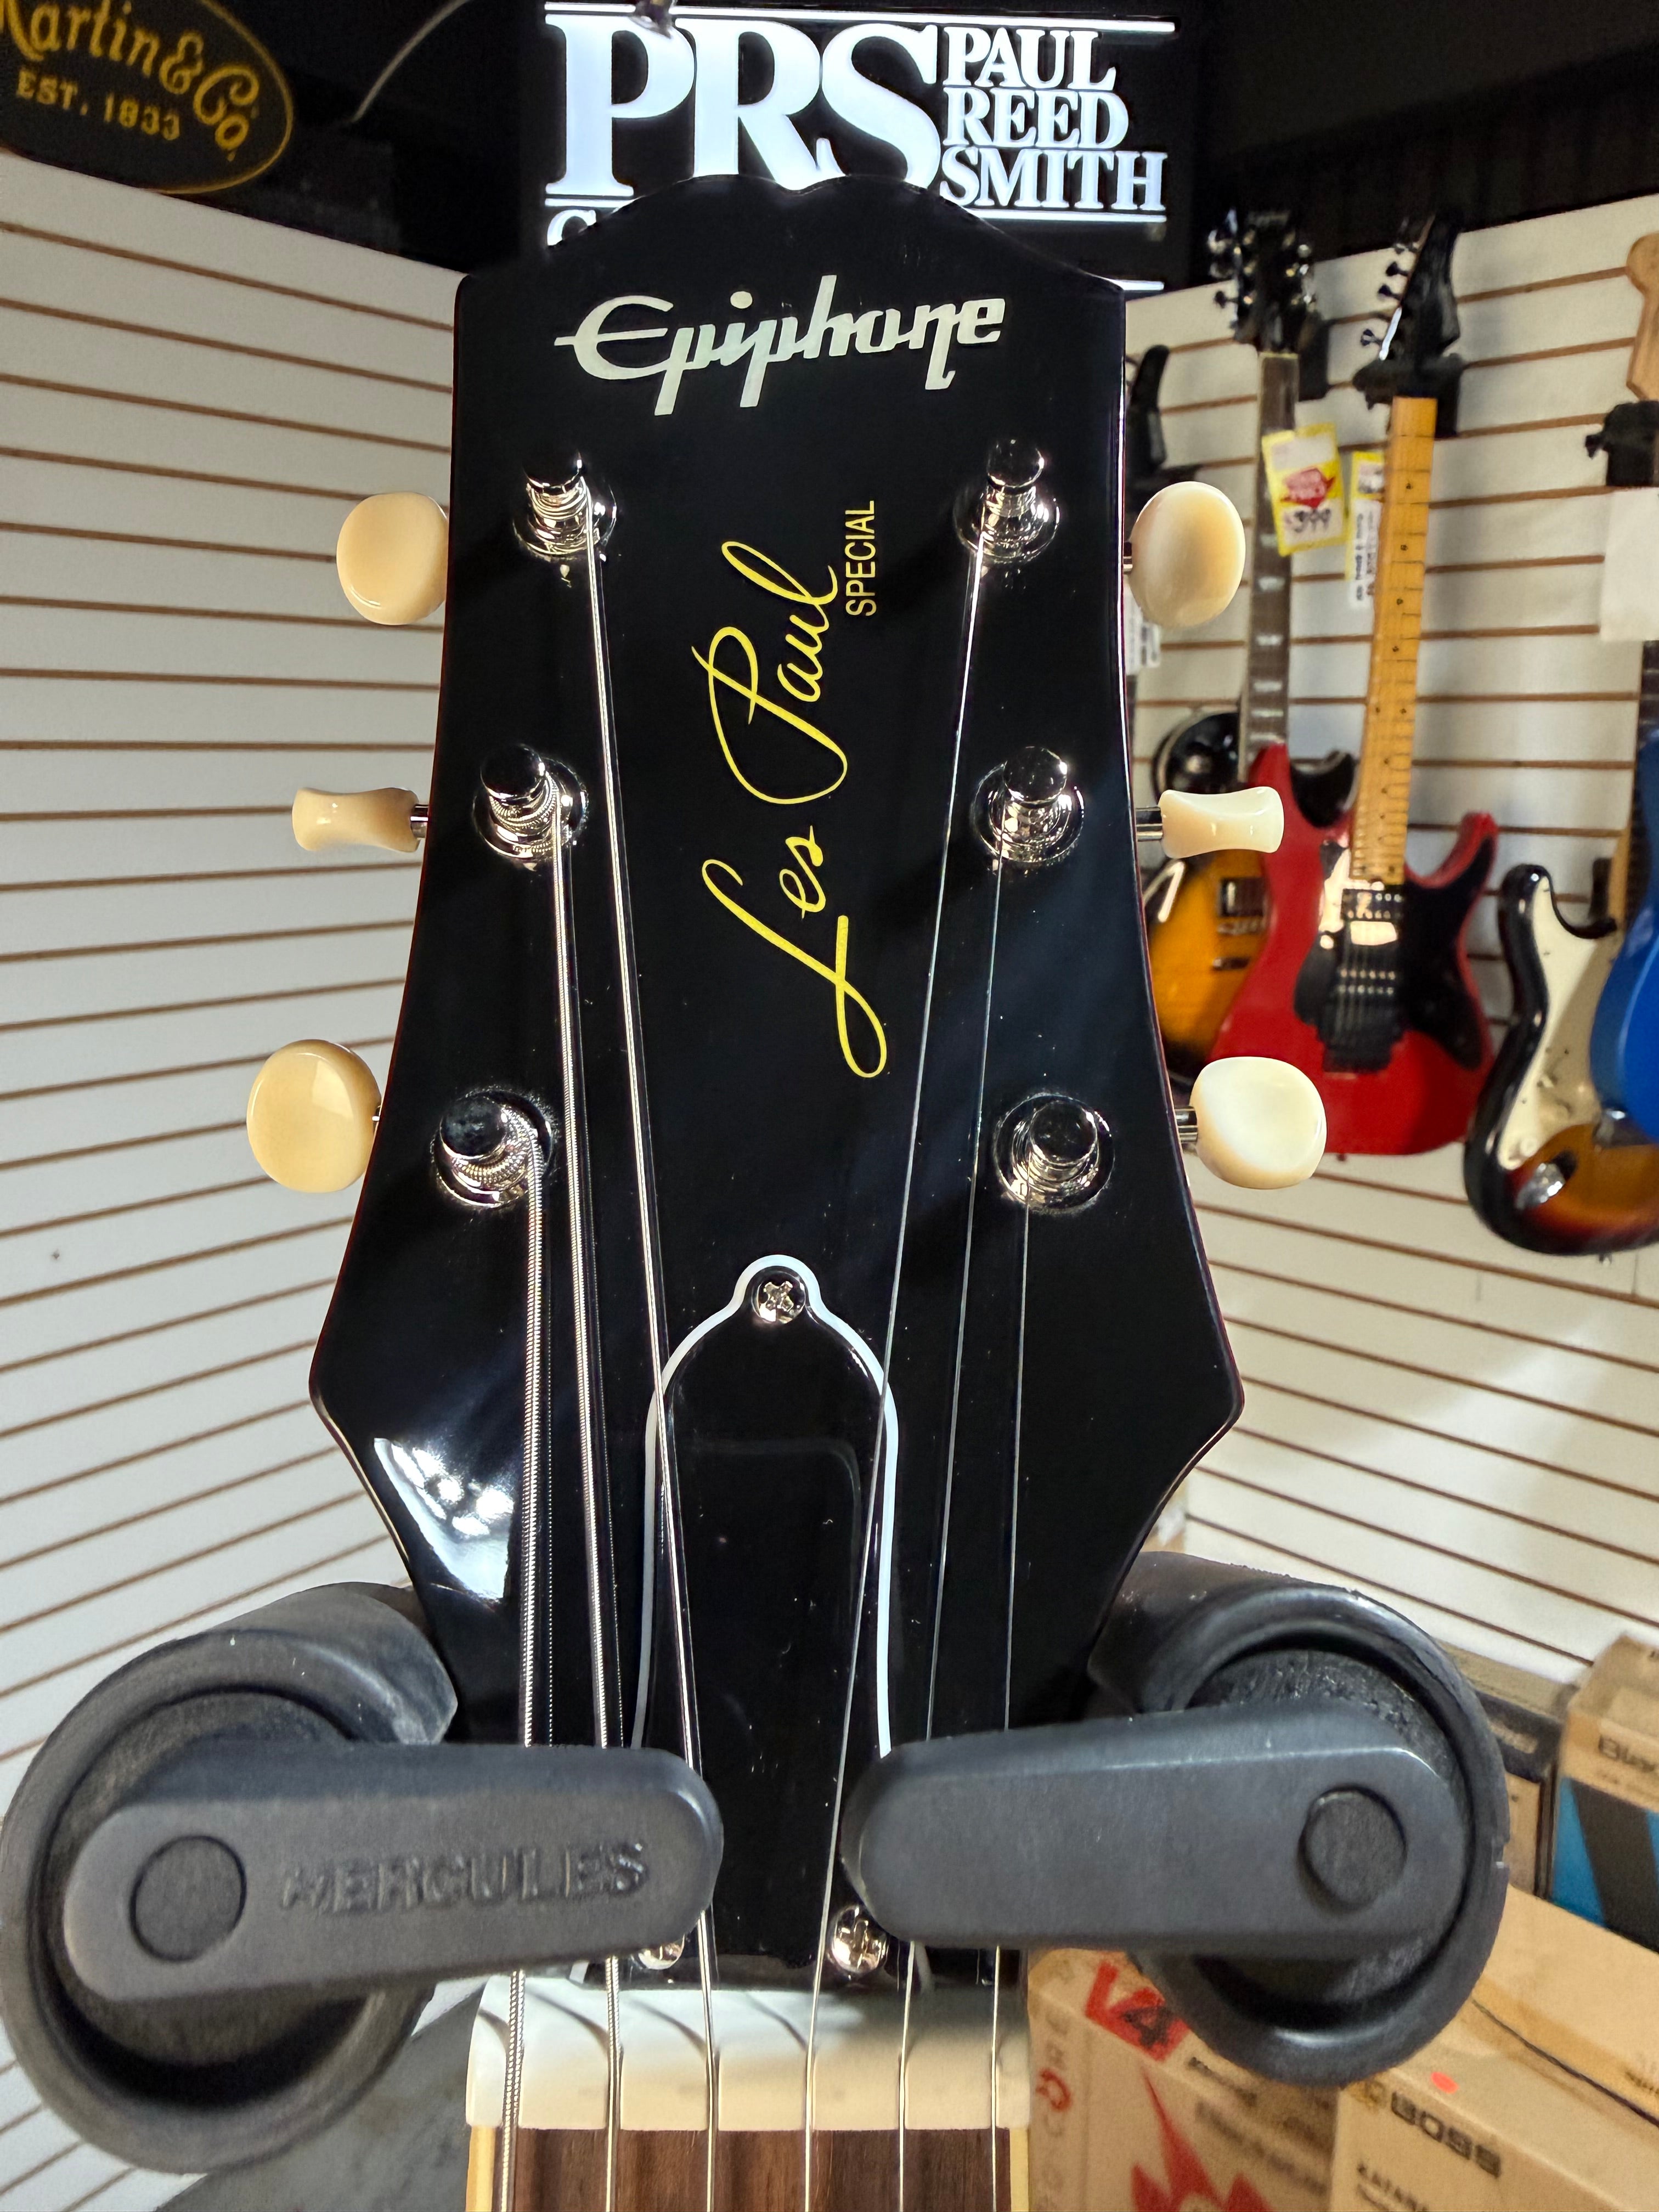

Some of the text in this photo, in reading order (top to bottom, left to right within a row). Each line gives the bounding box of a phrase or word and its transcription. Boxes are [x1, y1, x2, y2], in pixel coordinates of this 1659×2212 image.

[16, 67, 88, 116] EST.
[943, 27, 1117, 91] PAUL
[545, 14, 940, 199] PRS
[943, 87, 1130, 149] REED
[939, 146, 1169, 211] SMITH
[554, 274, 1006, 416] Epiphone
[844, 500, 877, 617] SPECIAL
[691, 541, 888, 1079] Les Paul
[280, 1841, 649, 1914] HERCULES
